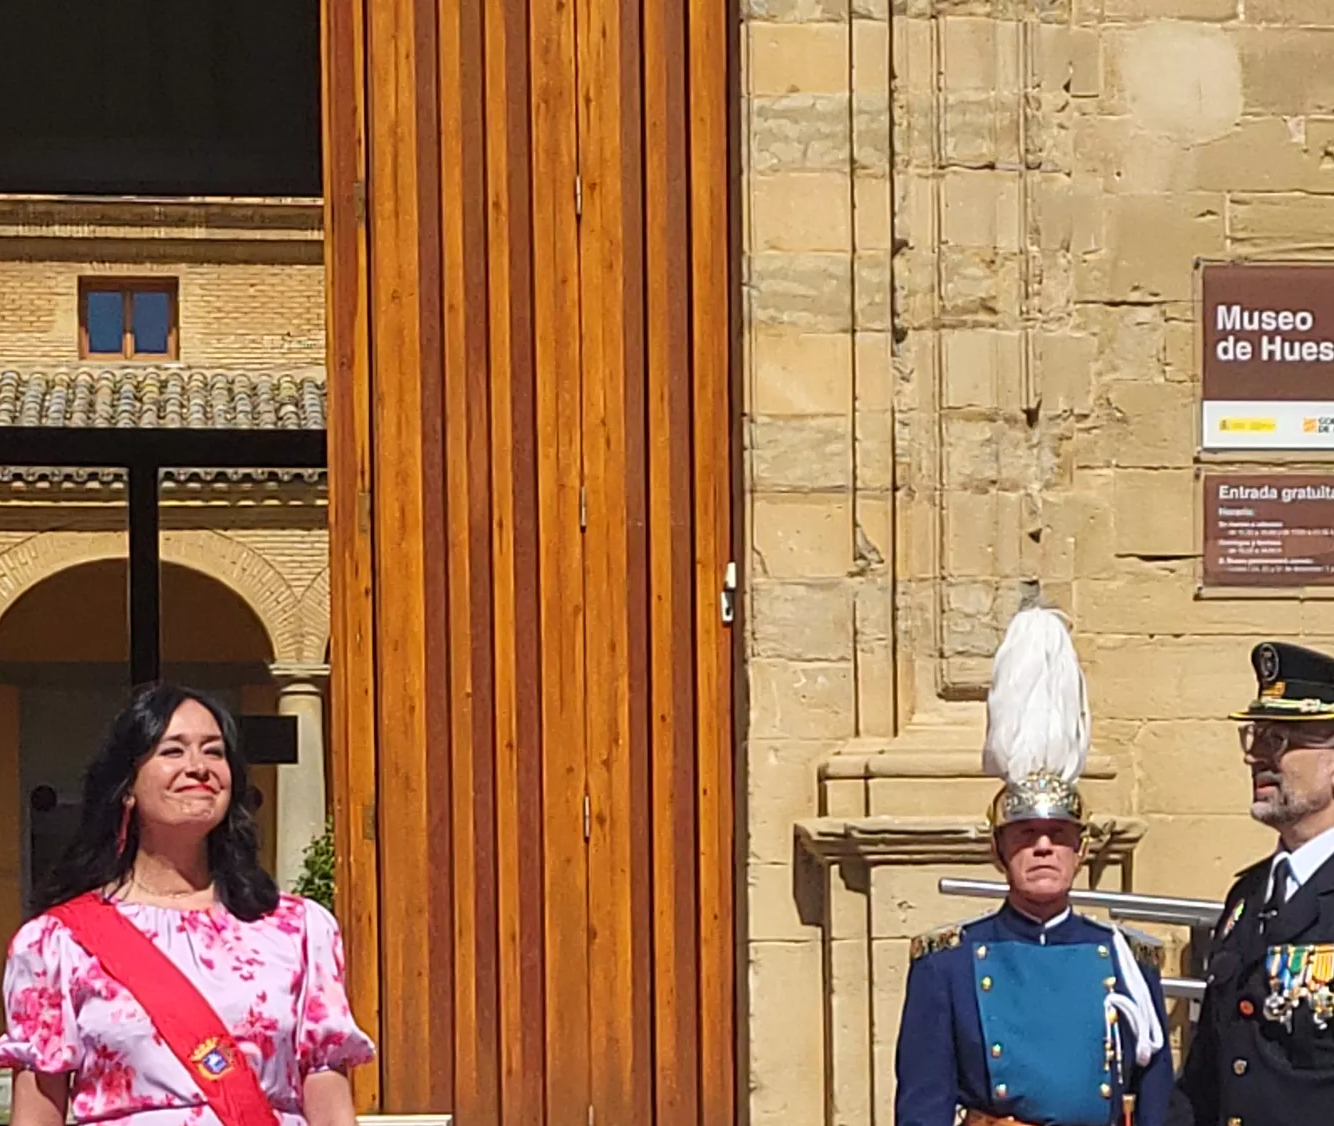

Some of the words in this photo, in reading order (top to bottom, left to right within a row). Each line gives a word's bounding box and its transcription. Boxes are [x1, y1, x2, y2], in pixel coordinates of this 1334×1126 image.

[1216, 305, 1313, 331] Museo
[1216, 335, 1252, 361] de
[1218, 485, 1278, 499] Entrada
